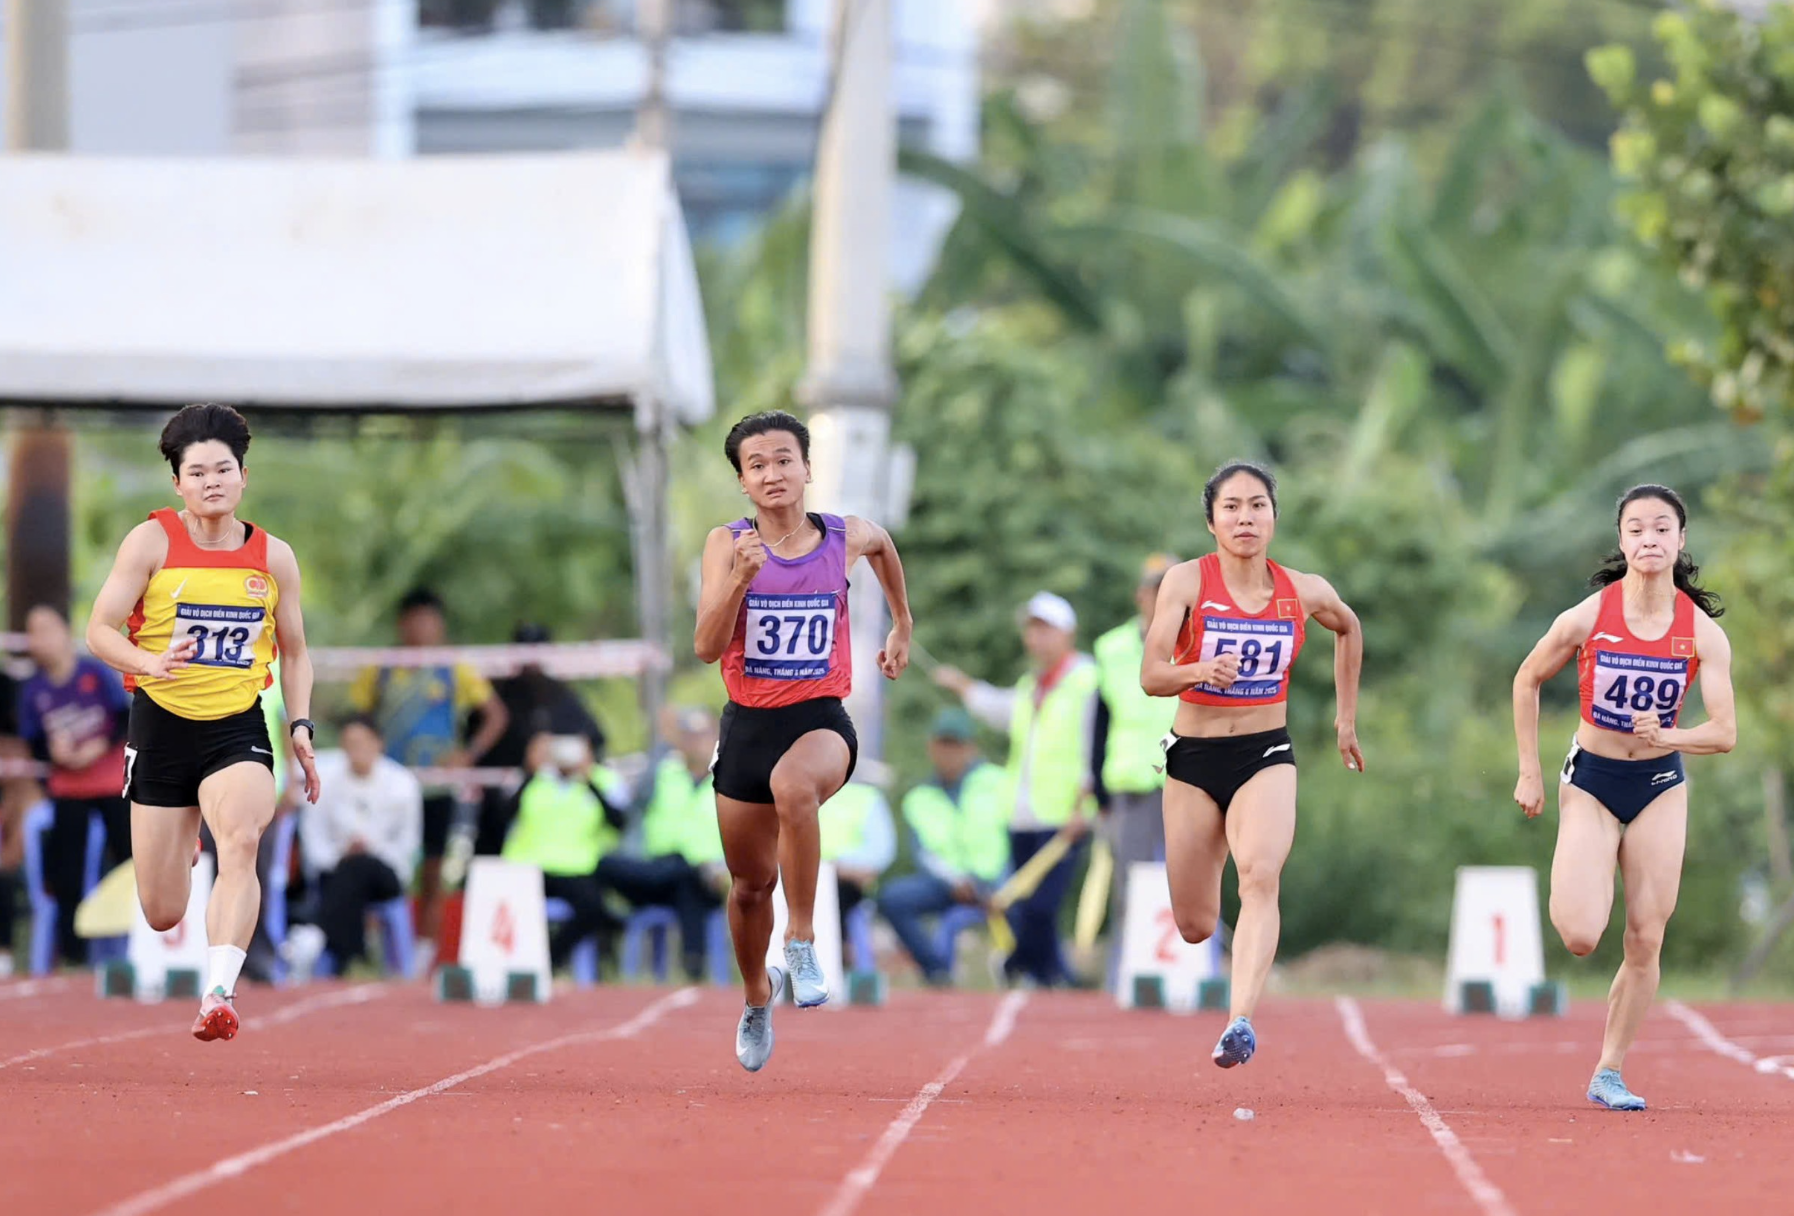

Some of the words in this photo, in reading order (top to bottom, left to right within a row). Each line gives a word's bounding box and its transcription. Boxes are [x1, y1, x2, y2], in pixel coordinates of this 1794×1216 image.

[187, 625, 249, 660] 313
[757, 614, 828, 655] 370
[1214, 638, 1282, 677] 581
[1604, 675, 1680, 711] 489
[490, 898, 515, 955] 4
[1154, 907, 1179, 964] 2
[1492, 911, 1506, 966] 1
